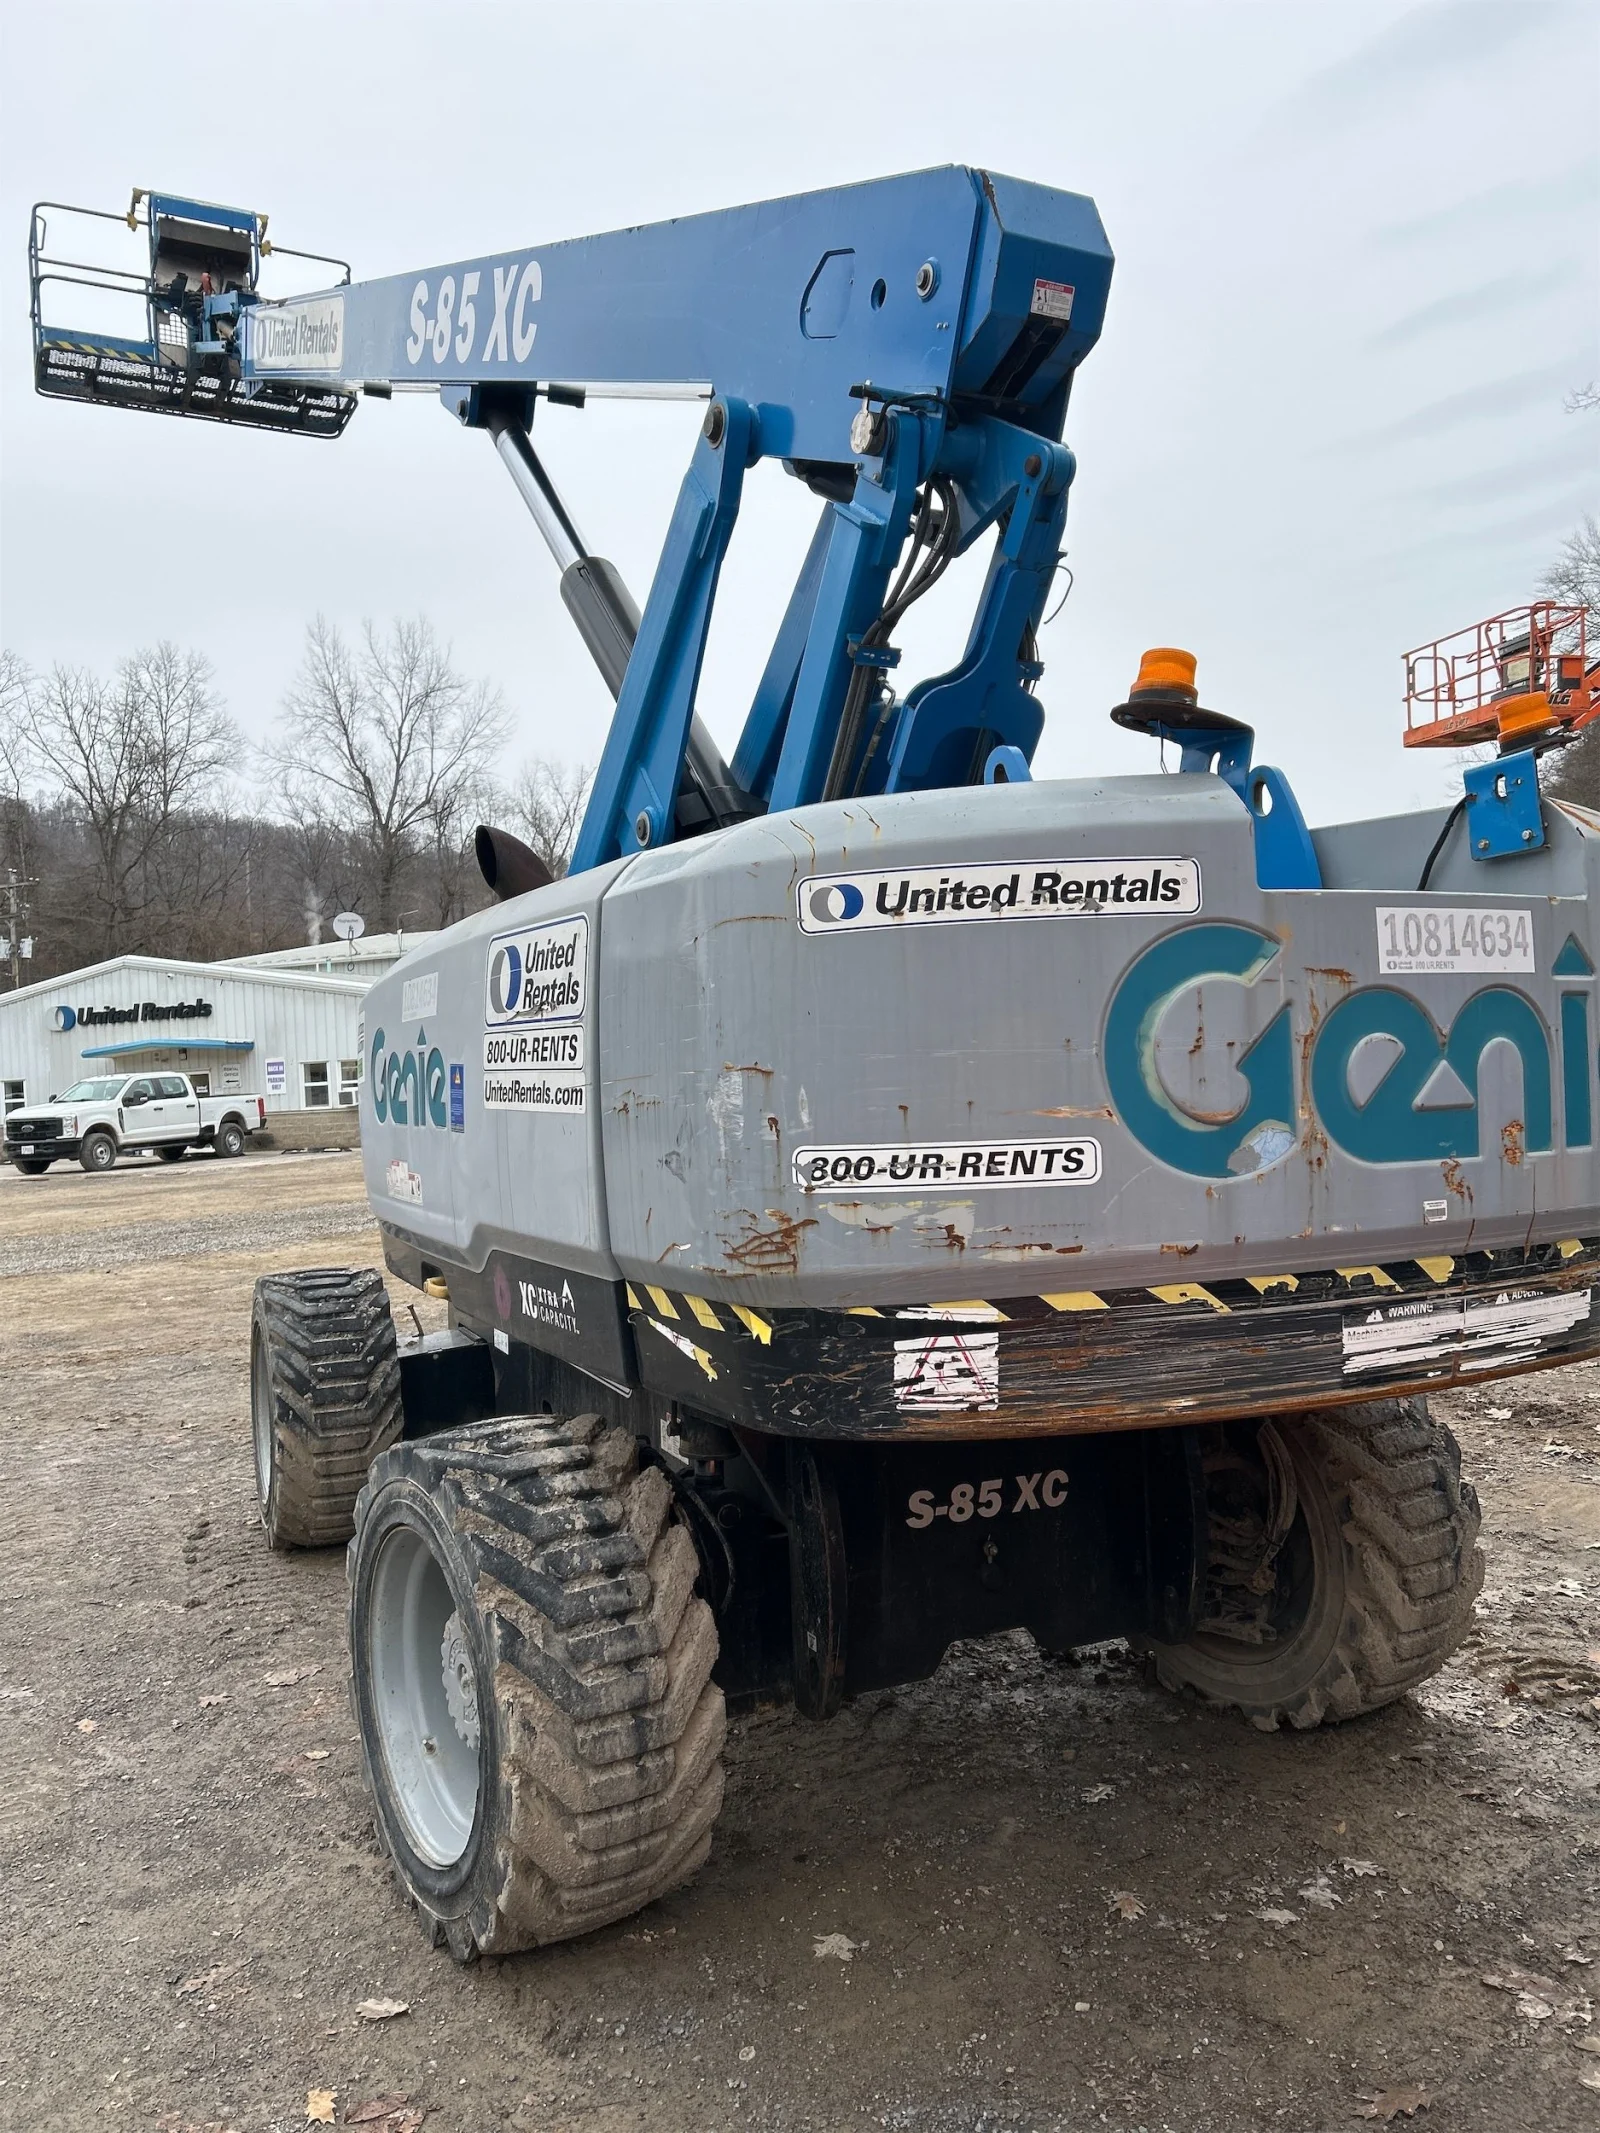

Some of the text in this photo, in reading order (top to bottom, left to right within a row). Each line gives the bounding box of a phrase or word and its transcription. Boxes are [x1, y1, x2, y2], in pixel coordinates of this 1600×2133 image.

[406, 260, 543, 365] S-85 XC
[268, 311, 339, 358] United Rentals
[875, 869, 1181, 915] United Rentals
[525, 932, 578, 974] United
[1384, 912, 1530, 958] 10814634
[523, 971, 580, 1010] Rentals
[77, 998, 213, 1027] United Rentals
[486, 1034, 578, 1064] 800-UR-RENTS
[1103, 924, 1600, 1178] Geni
[370, 1024, 447, 1128] Genie
[484, 1079, 583, 1106] UnitedRentals.com
[809, 1146, 1085, 1182] 800-UR-RENTS
[518, 1280, 538, 1319] XC
[538, 1286, 559, 1308] XTRA
[1388, 1302, 1434, 1318] WARNING
[540, 1305, 577, 1334] CAPACITY
[905, 1469, 1069, 1529] S-85 XC
